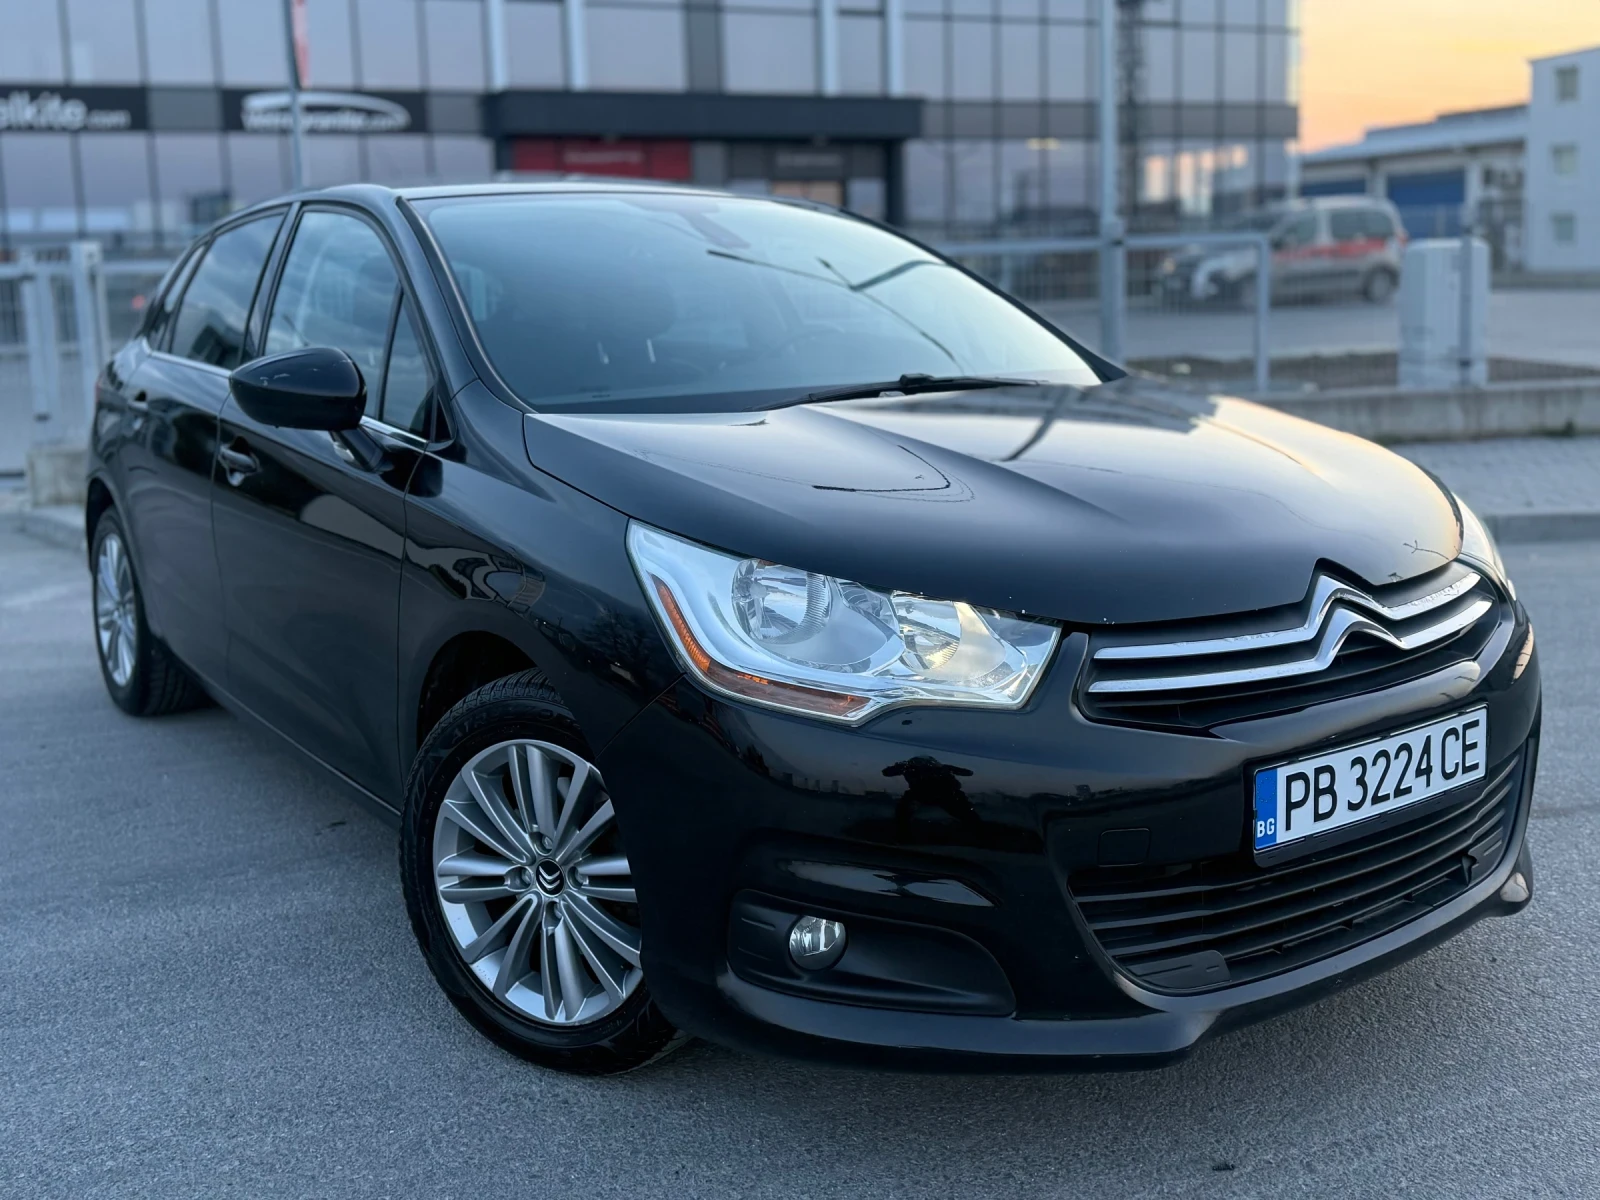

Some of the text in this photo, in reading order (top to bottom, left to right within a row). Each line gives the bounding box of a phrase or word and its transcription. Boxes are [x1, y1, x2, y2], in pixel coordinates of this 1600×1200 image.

[1284, 718, 1480, 831] PB 3224 CE
[1256, 817, 1275, 838] BG
